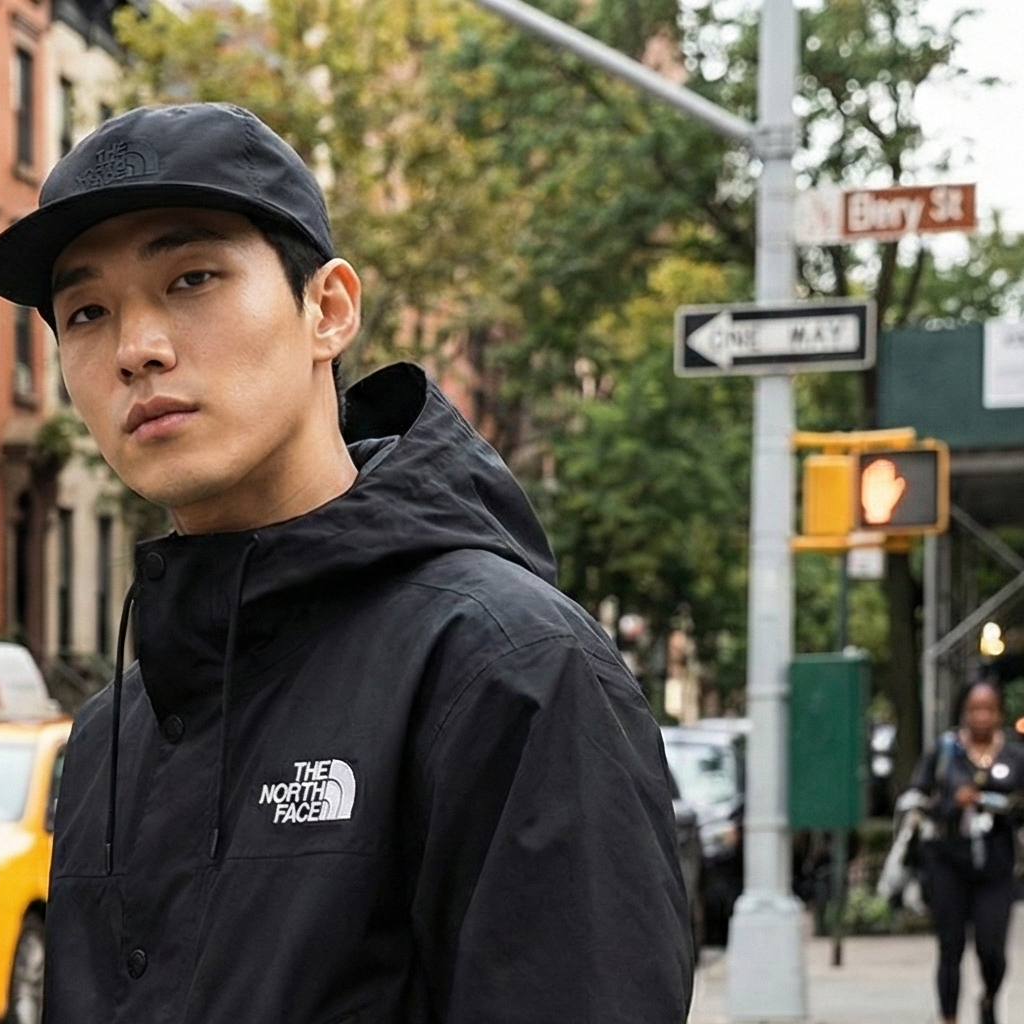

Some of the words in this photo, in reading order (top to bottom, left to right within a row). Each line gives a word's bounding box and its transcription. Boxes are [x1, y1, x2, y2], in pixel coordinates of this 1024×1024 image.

[294, 760, 331, 782] THE
[259, 780, 327, 804] NORTH
[273, 801, 322, 823] FACE
